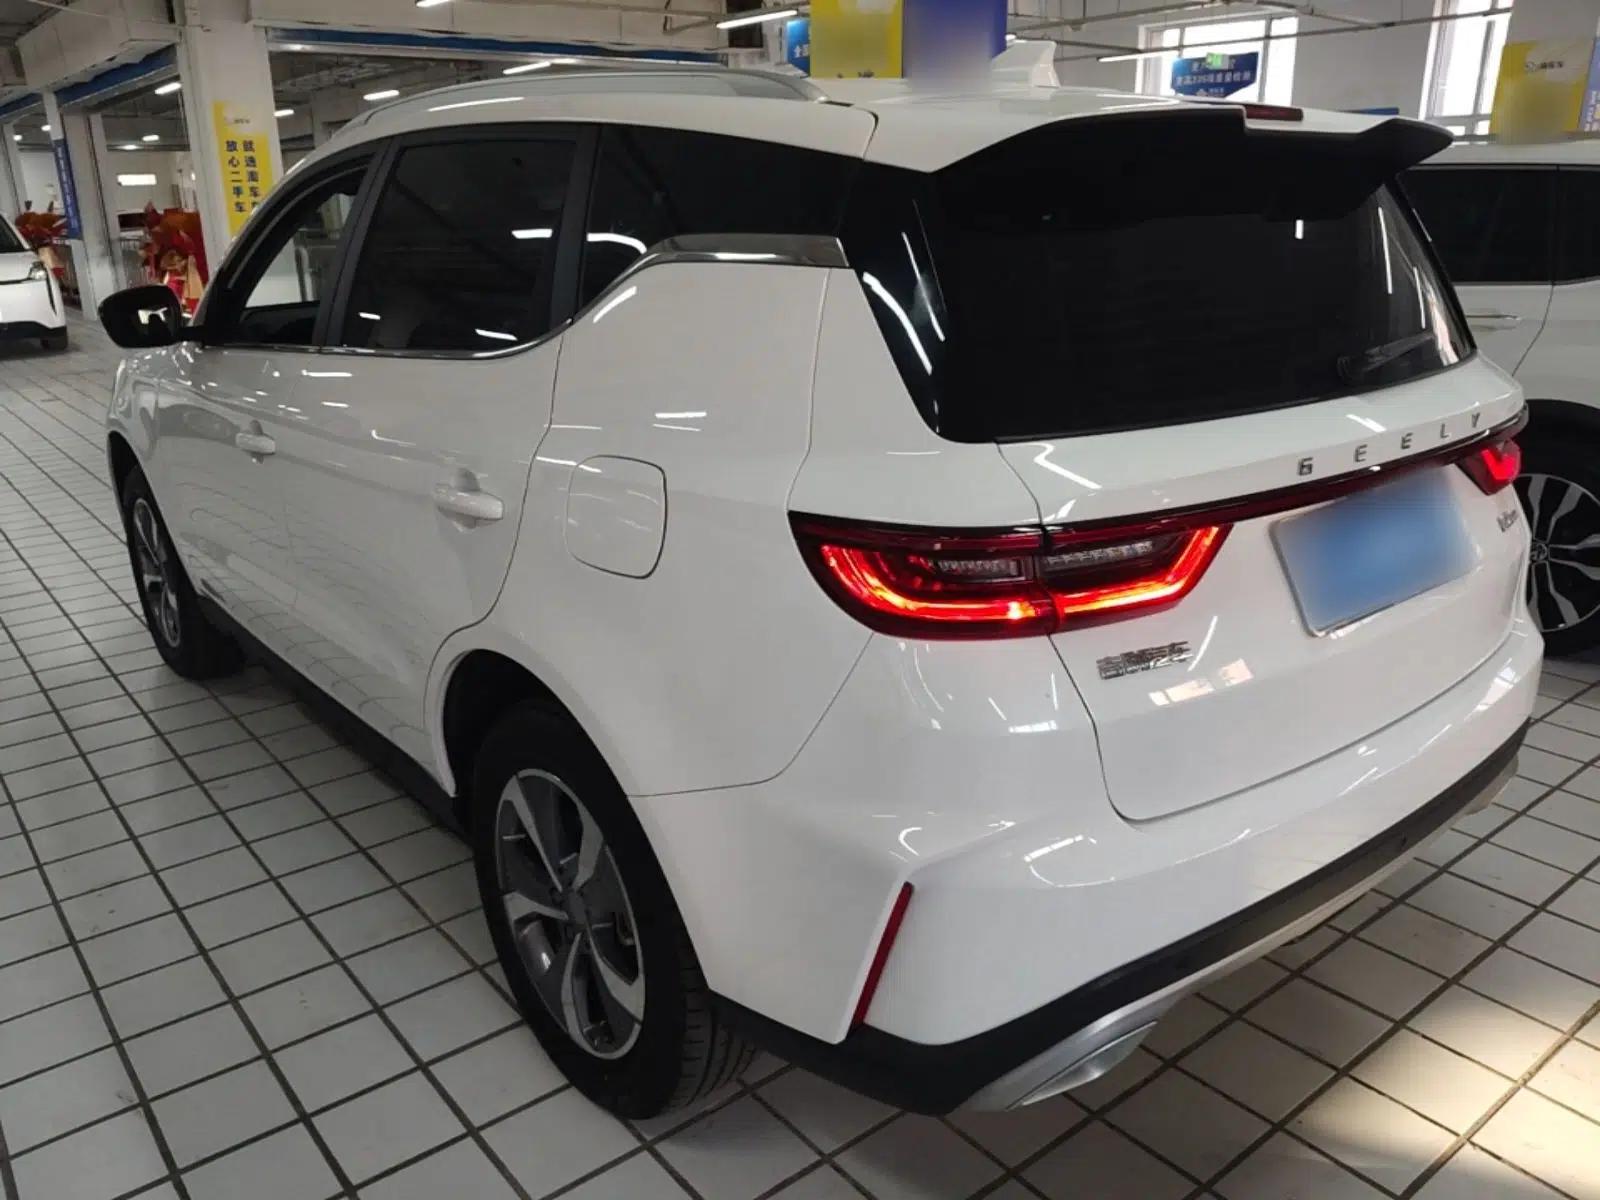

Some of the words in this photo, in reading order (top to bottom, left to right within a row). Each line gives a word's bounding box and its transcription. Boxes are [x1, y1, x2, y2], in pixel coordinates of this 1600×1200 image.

[225, 139, 247, 213] 放心二手车
[1297, 412, 1480, 476] GEELY
